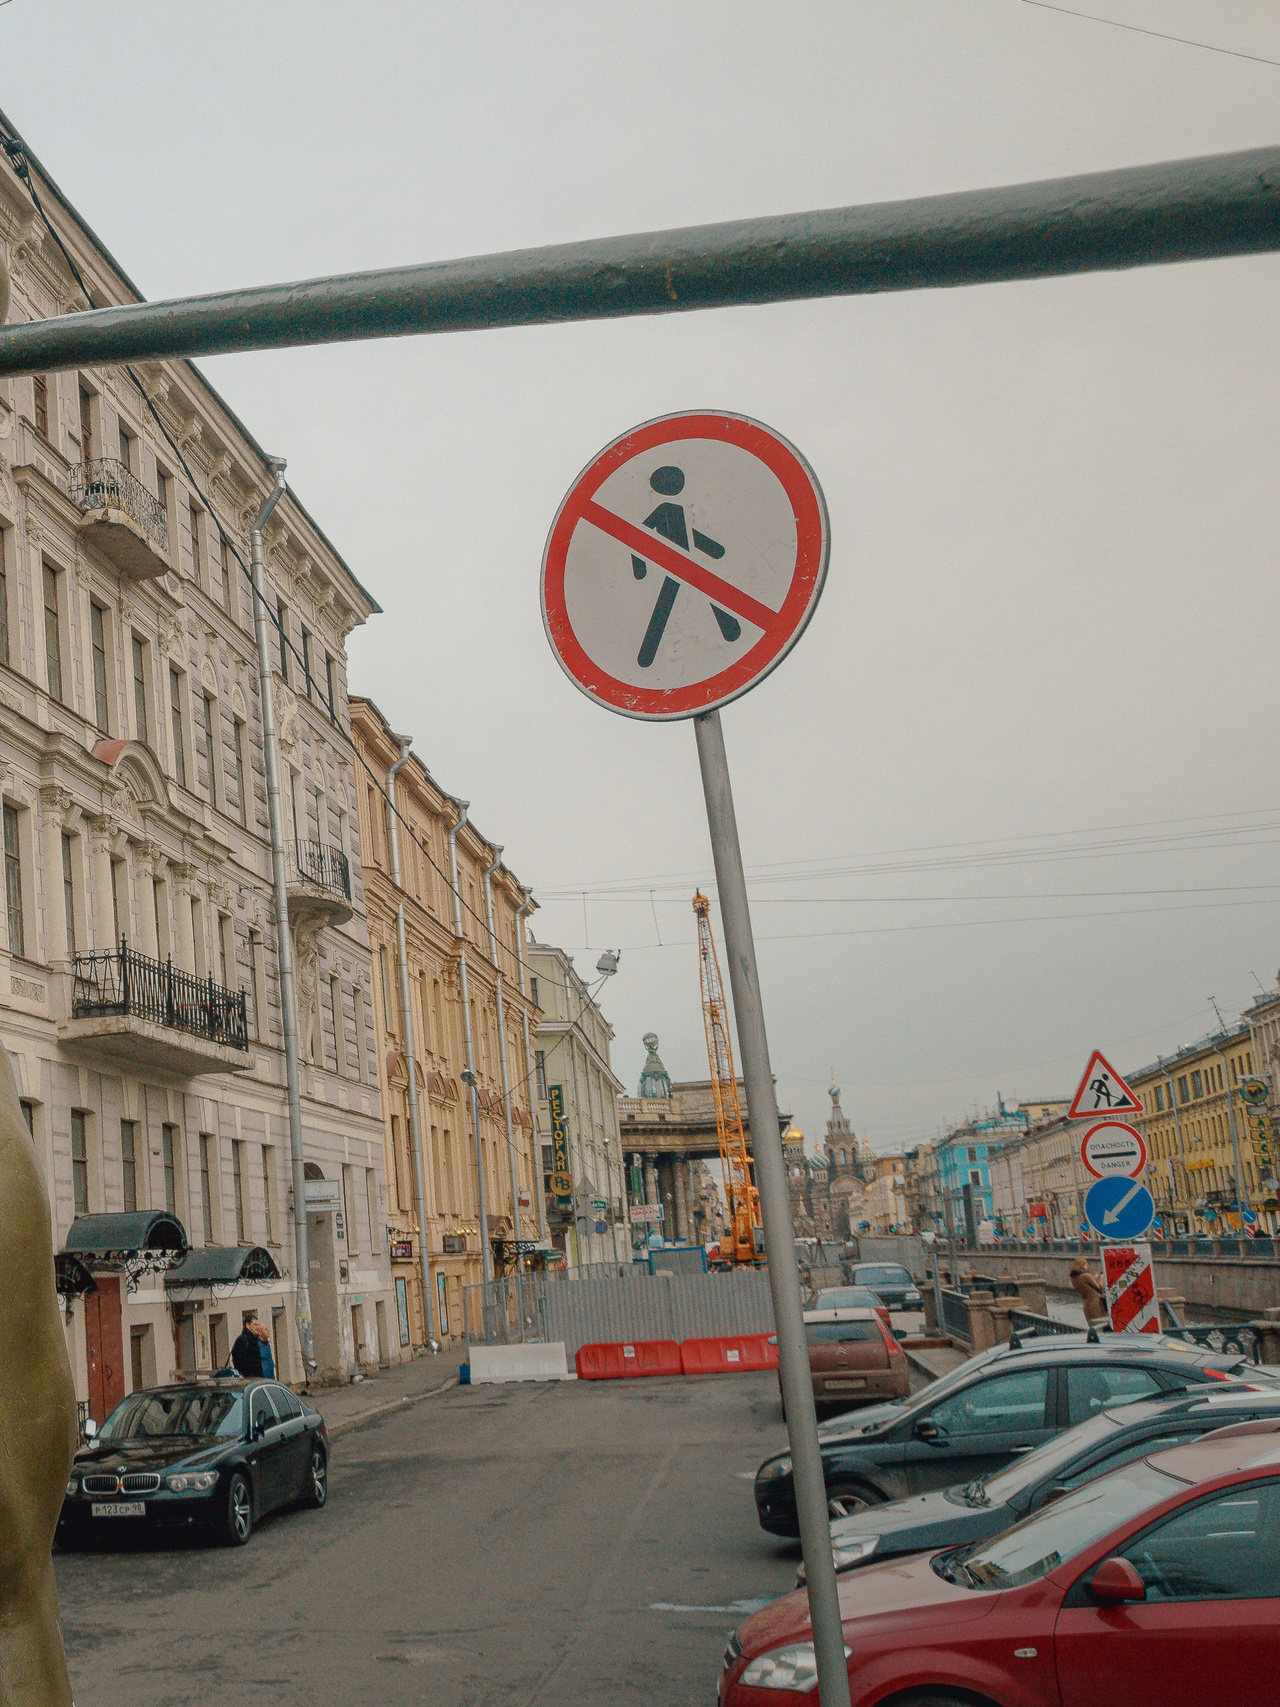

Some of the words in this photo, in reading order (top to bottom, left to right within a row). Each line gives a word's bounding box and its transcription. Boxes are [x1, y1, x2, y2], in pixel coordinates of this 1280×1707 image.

[551, 1089, 566, 1171] РЕСТОРАН
[1090, 1141, 1135, 1150] ОПАСНОСТЬ
[1101, 1161, 1131, 1169] DANGER
